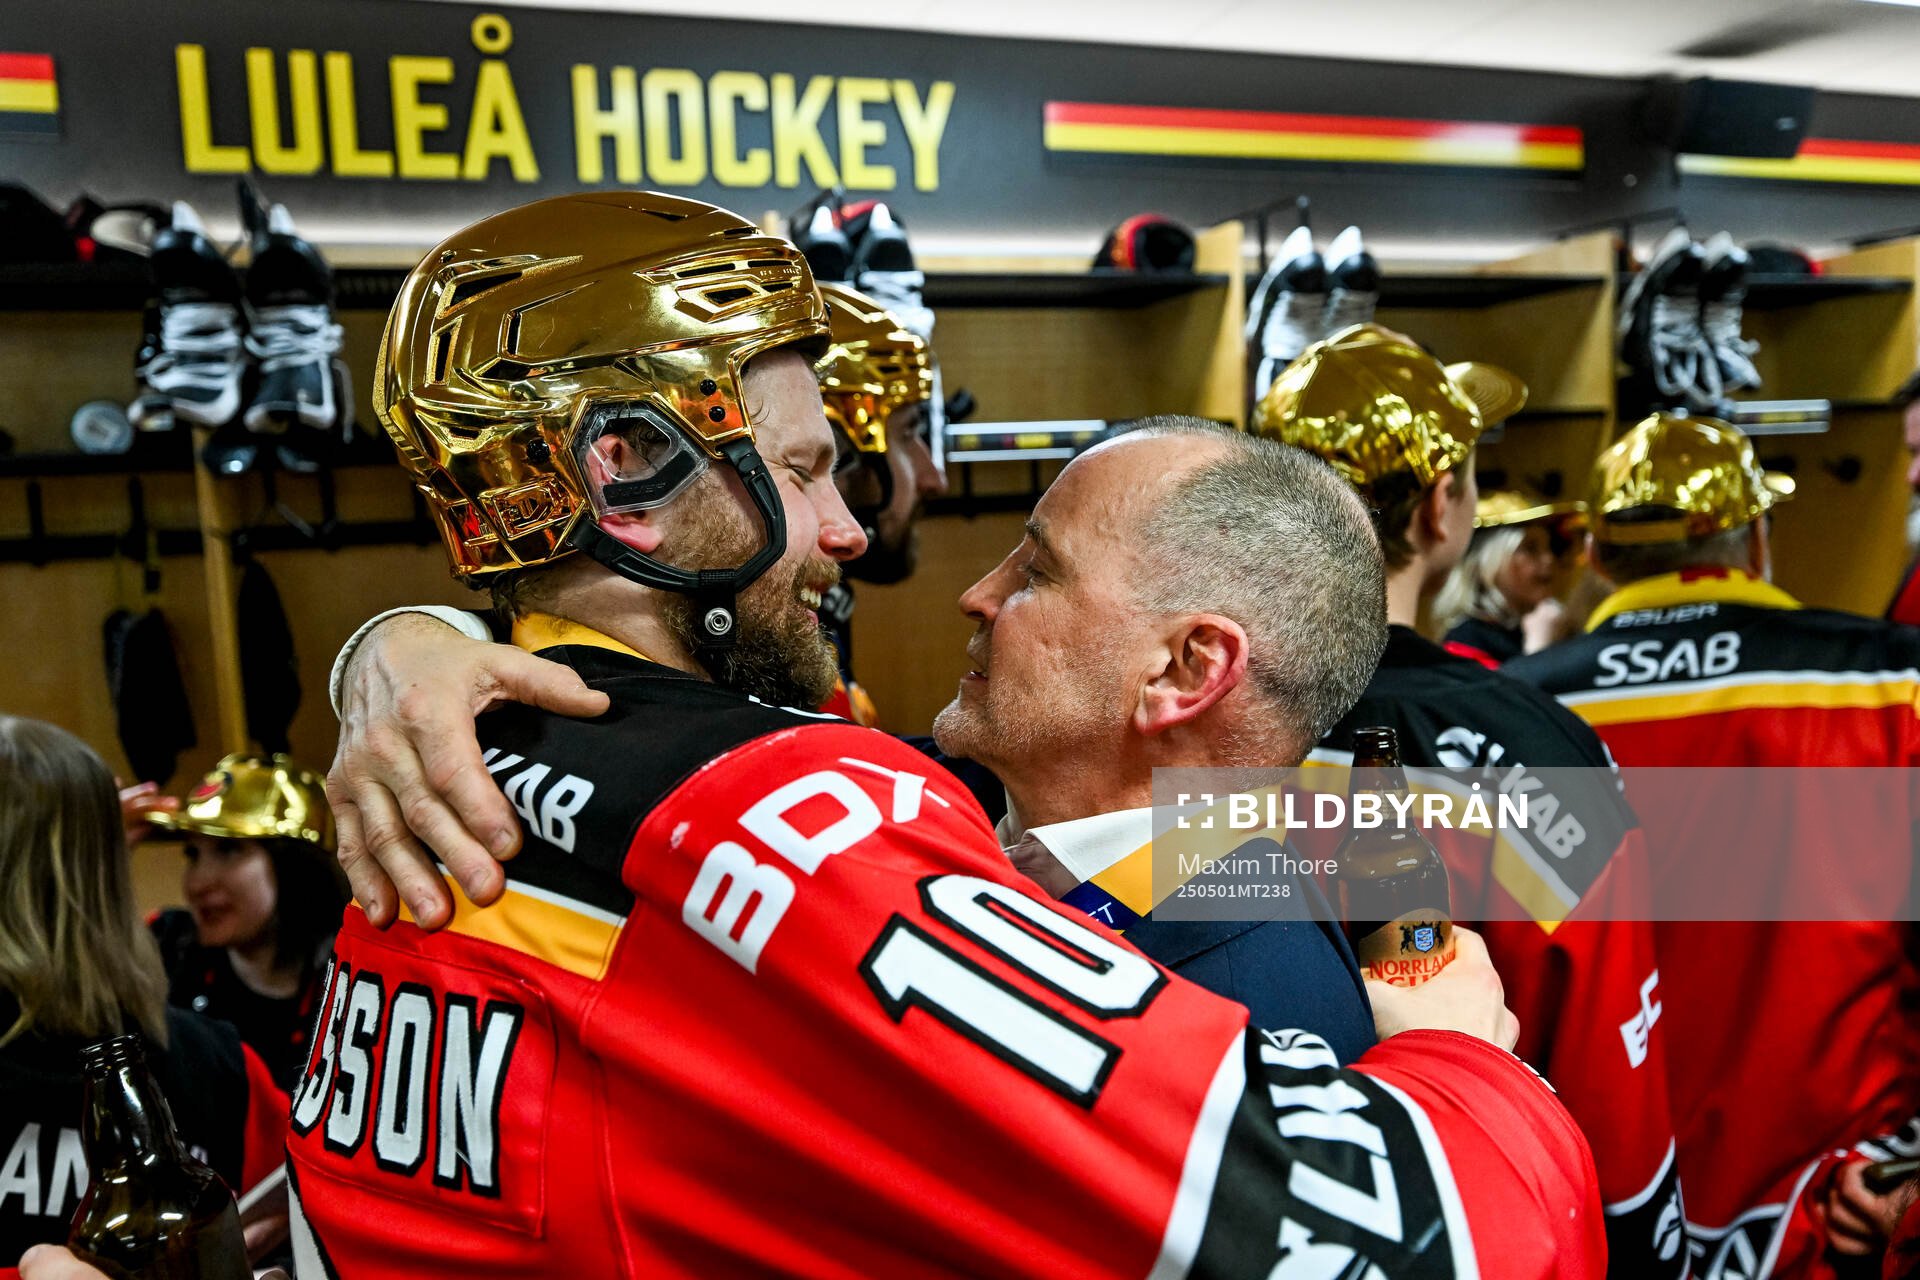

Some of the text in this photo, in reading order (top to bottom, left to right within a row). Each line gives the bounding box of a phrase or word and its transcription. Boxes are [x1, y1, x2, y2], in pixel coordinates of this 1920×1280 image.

[175, 15, 955, 191] LULEÅ HOCKEY
[1594, 631, 1741, 687] SSAB
[290, 951, 525, 1199] SSON
[857, 874, 1170, 1109] 10
